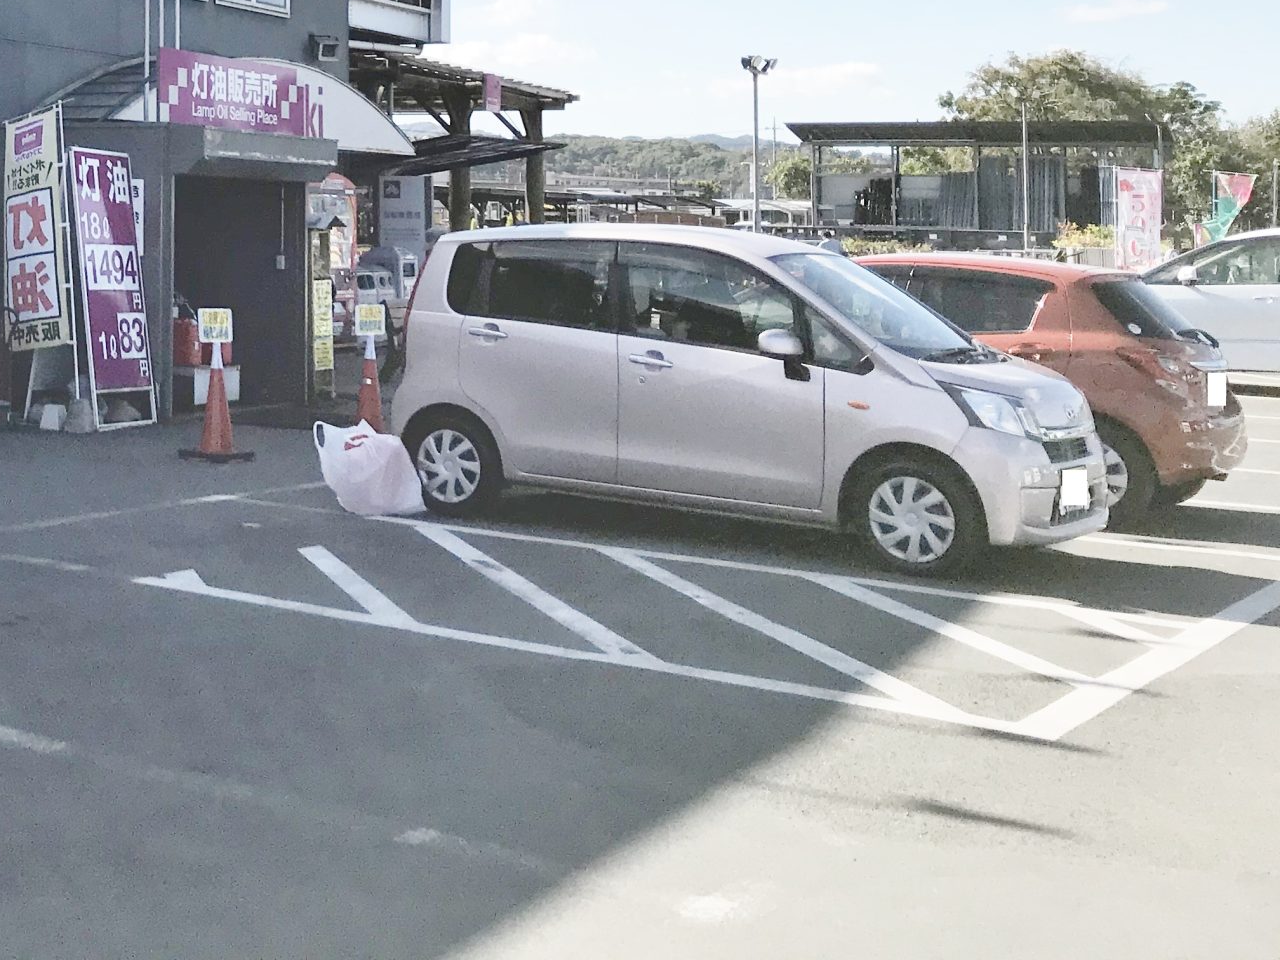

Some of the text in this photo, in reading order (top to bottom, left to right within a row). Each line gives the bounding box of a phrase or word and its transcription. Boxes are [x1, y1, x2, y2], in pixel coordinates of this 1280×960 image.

[192, 62, 278, 108] 灯油販売所
[192, 101, 278, 127] Lamp Oil Selling Place
[79, 156, 130, 204] 灯油
[87, 249, 138, 286] 1494
[119, 317, 145, 354] 83
